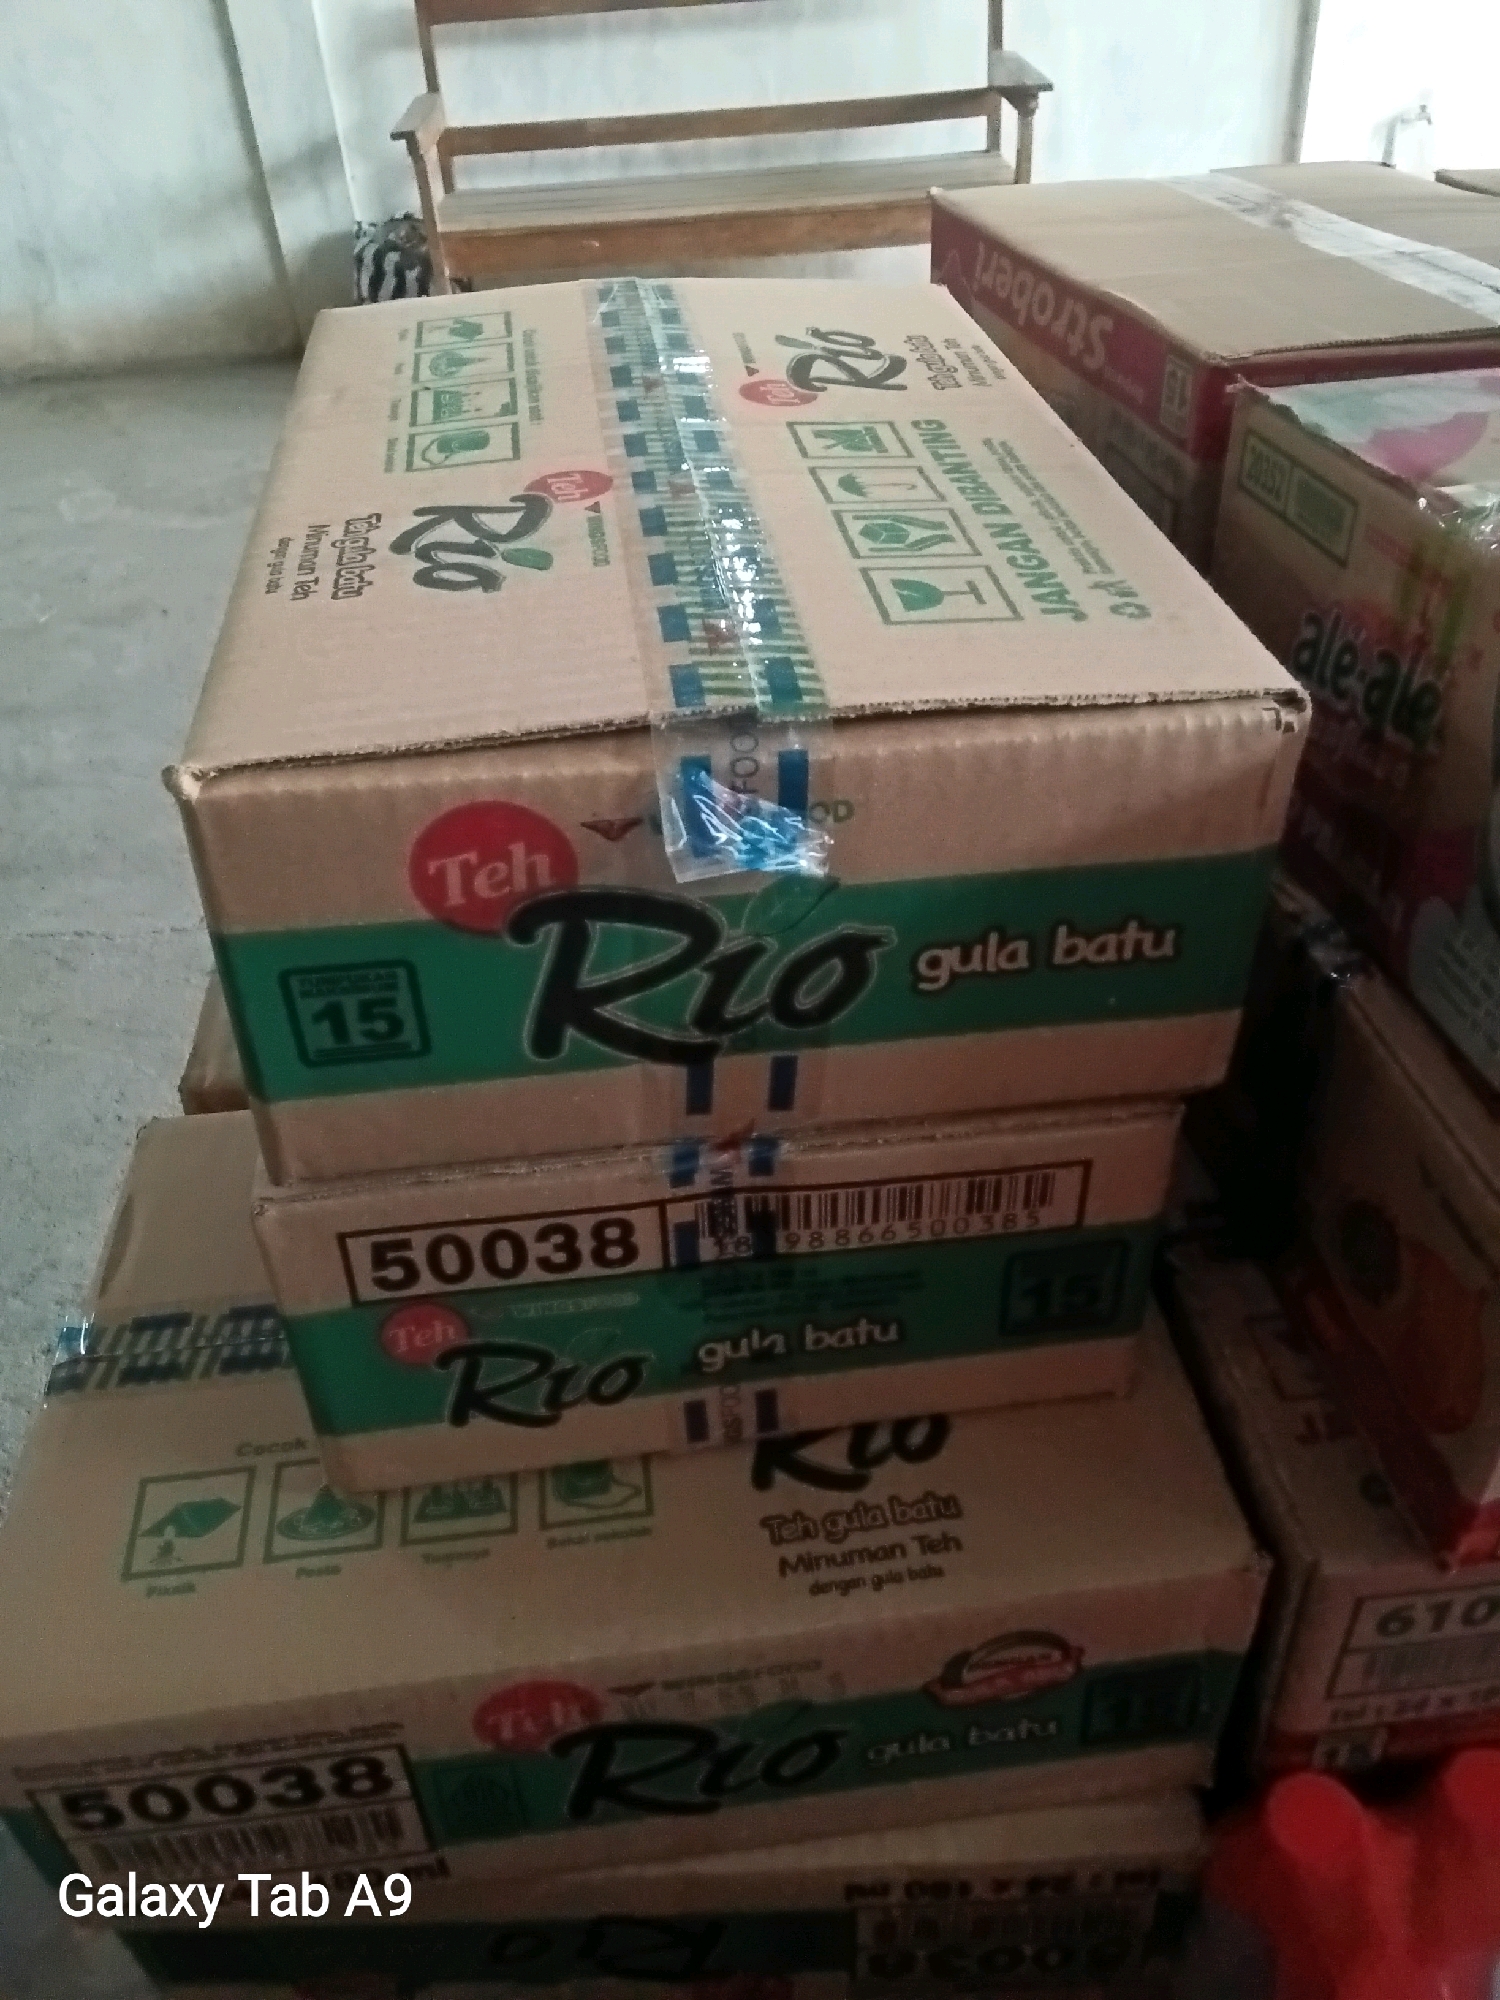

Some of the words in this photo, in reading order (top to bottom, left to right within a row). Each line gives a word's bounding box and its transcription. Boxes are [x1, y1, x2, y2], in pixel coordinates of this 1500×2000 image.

[973, 240, 1113, 371] Stroberi
[778, 327, 907, 392] Rio
[547, 471, 586, 501] Teh
[911, 419, 1012, 515] DIBANTING
[296, 525, 332, 577] Minuman
[330, 537, 376, 566] gula
[342, 513, 382, 538] Teh
[388, 493, 556, 593] Rio
[290, 576, 322, 601] Teh
[331, 564, 378, 600] batu
[983, 521, 1088, 622] JANGAN
[428, 843, 558, 909] Teh
[506, 886, 897, 1065] Rio
[916, 931, 1029, 992] gula
[1053, 920, 1176, 966] batu
[310, 997, 405, 1045] 15
[370, 1217, 640, 1292] 50038
[389, 1321, 456, 1352] Teh
[804, 1317, 899, 1352] batu
[434, 1340, 655, 1428] Rio
[759, 1510, 819, 1546] Teh
[821, 1500, 890, 1545] gula
[887, 1490, 964, 1526] batu
[777, 1542, 907, 1578] Minuman
[911, 1530, 964, 1556] Teh
[550, 1721, 848, 1819] Rio
[865, 1732, 951, 1767] gula
[967, 1716, 1058, 1748] batu
[60, 1755, 394, 1833] 50038
